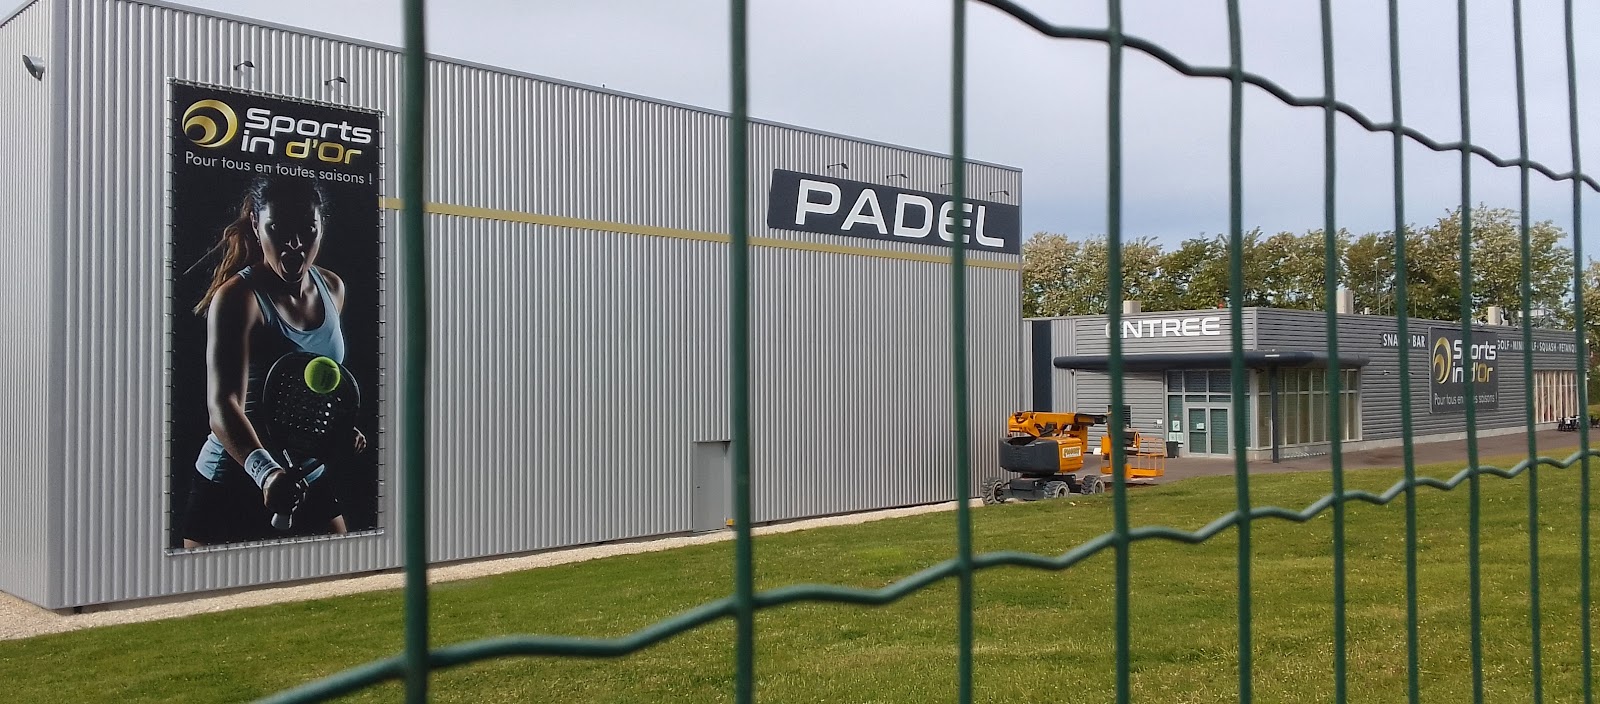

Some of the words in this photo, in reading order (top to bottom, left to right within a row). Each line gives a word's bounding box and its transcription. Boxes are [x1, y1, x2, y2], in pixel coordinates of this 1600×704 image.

[244, 107, 372, 144] Sports
[241, 129, 275, 155] in
[285, 137, 362, 164] d'Or
[185, 151, 218, 168] Pour
[221, 157, 251, 171] tous
[255, 163, 272, 174] en
[276, 163, 315, 179] toutes
[319, 169, 365, 184] saisons
[368, 173, 373, 185] !
[795, 178, 1005, 248] PADEL
[1383, 333, 1404, 347] SNA
[1412, 335, 1426, 348] BAR
[1453, 339, 1496, 363] Sorts
[1452, 361, 1464, 383] in
[1434, 392, 1446, 406] Pour
[1446, 394, 1457, 405] tous
